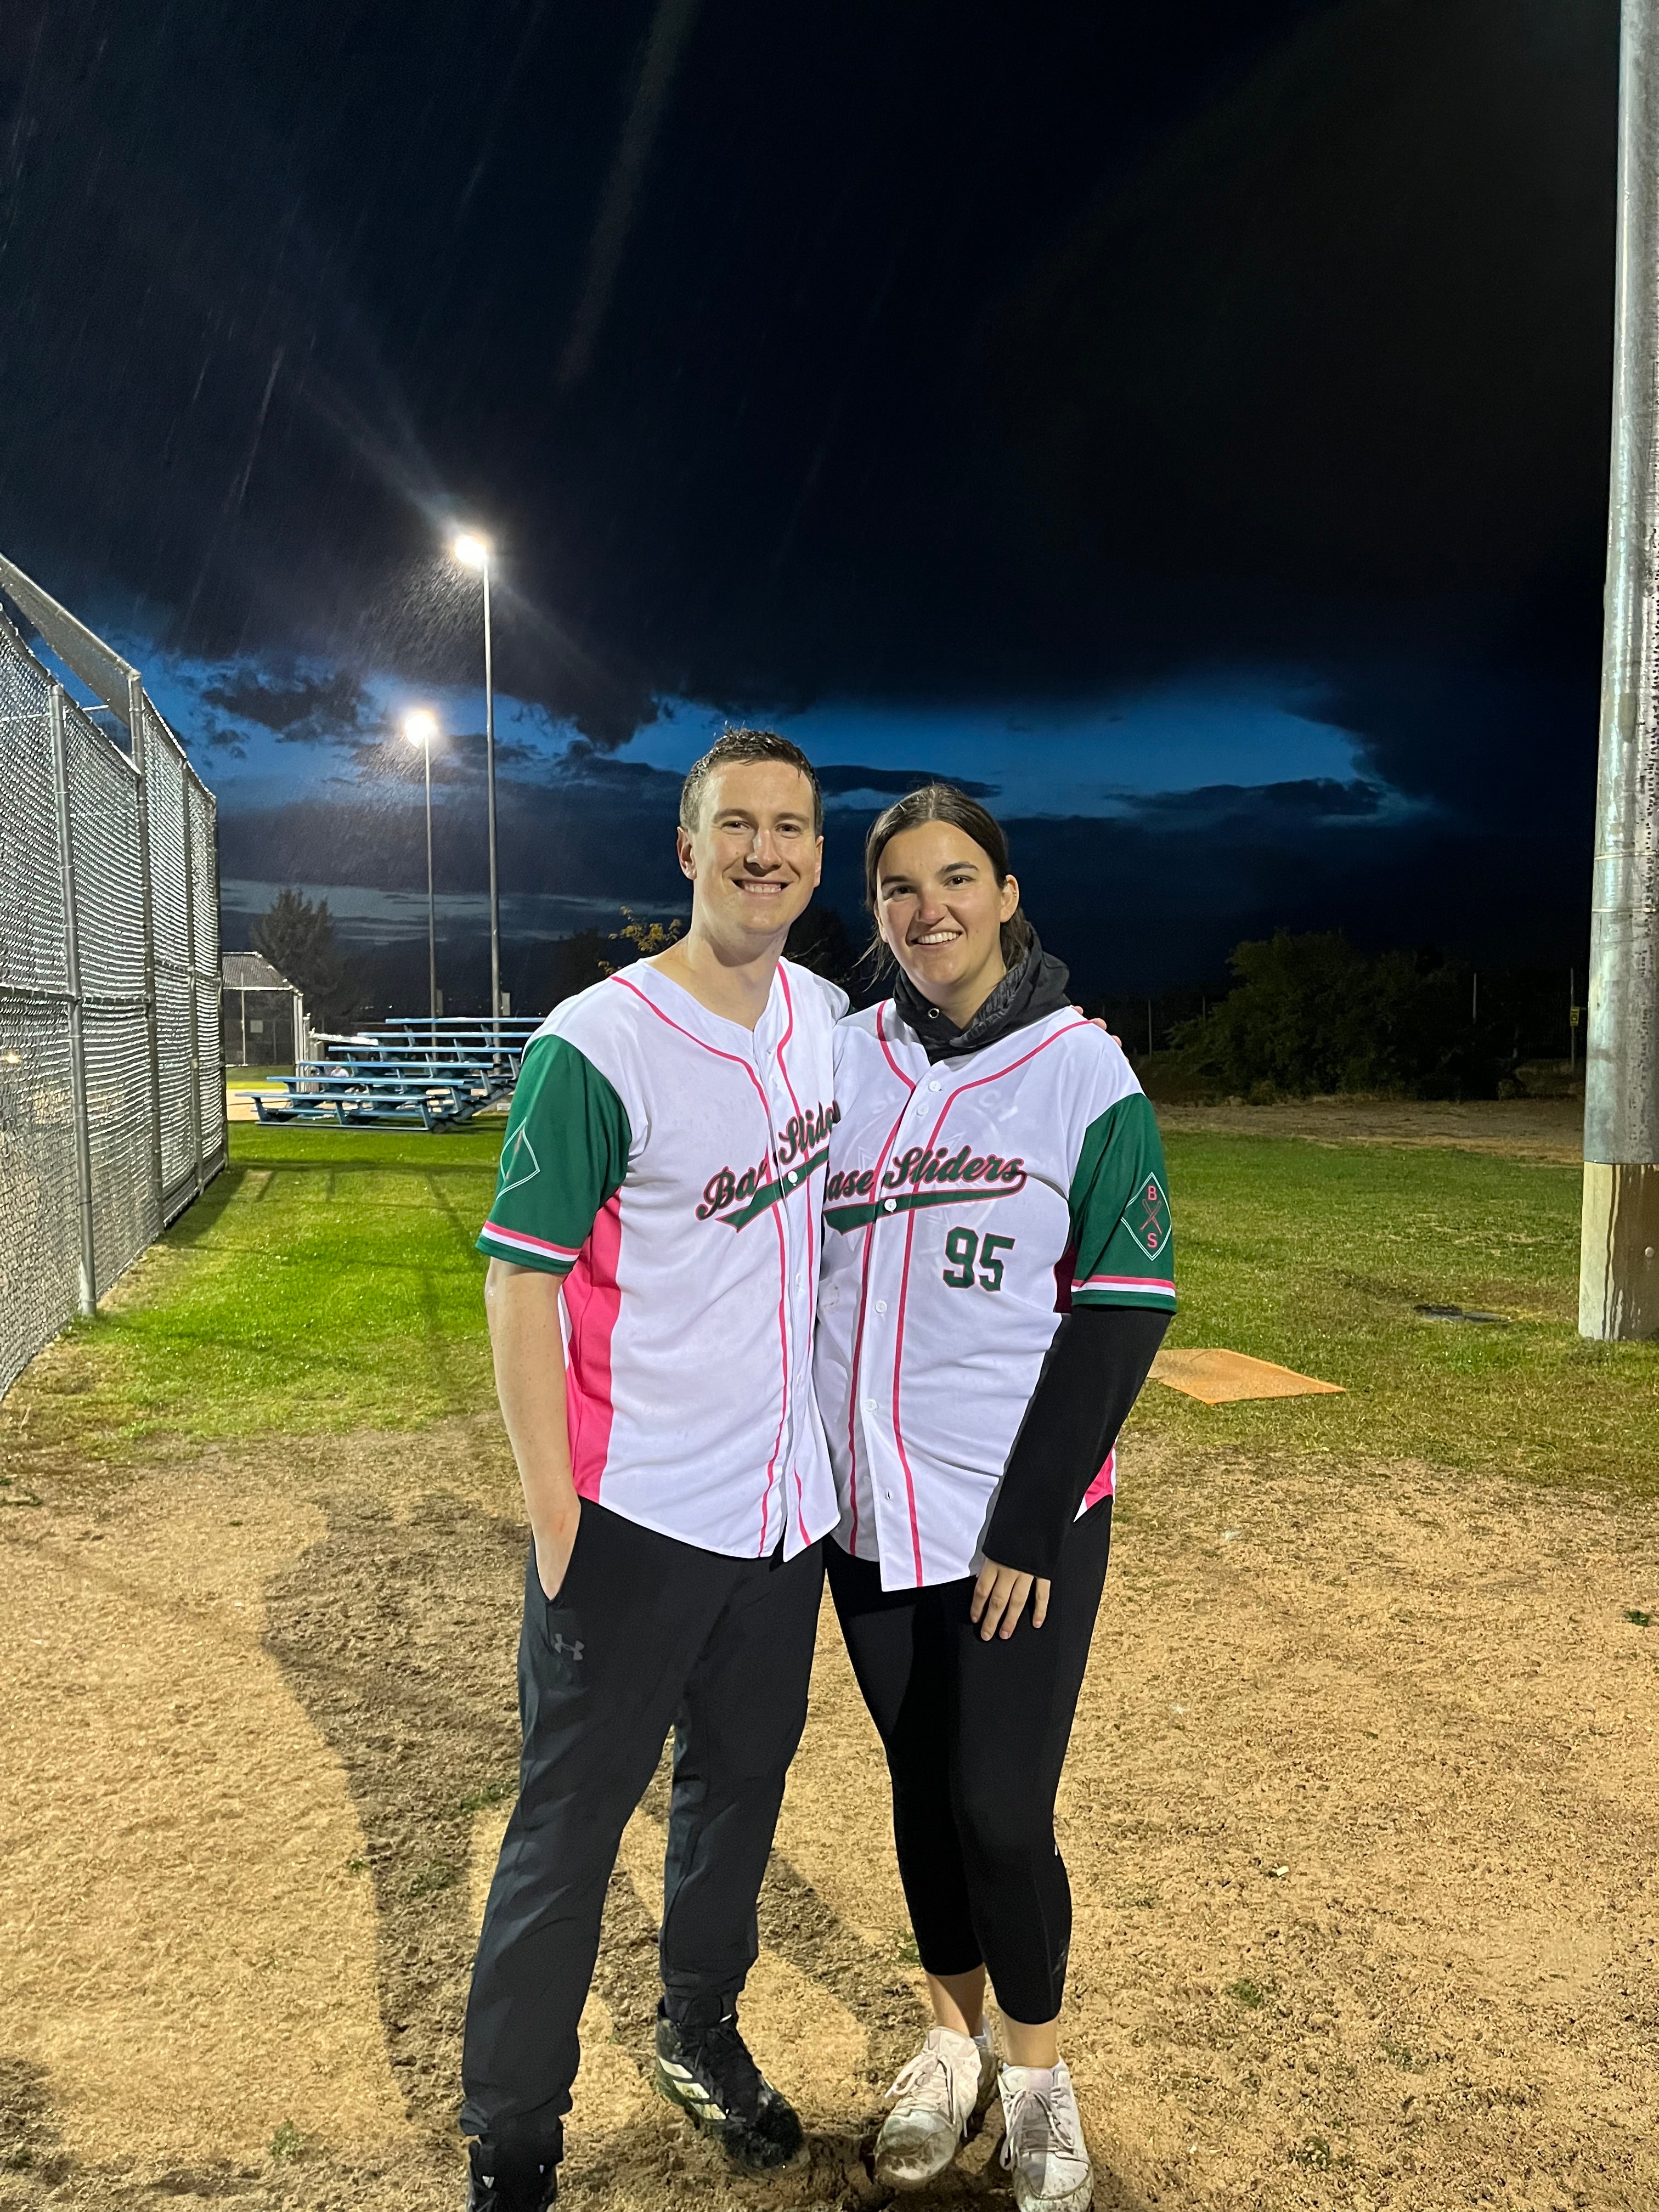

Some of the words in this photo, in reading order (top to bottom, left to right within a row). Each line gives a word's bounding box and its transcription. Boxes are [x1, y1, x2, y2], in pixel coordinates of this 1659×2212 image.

[695, 1159, 768, 1221] Ba
[824, 1169, 877, 1202] ase
[881, 1145, 1024, 1189] Sliders
[1148, 1186, 1157, 1200] B
[942, 1226, 1015, 1292] 95
[1147, 1233, 1157, 1248] S
